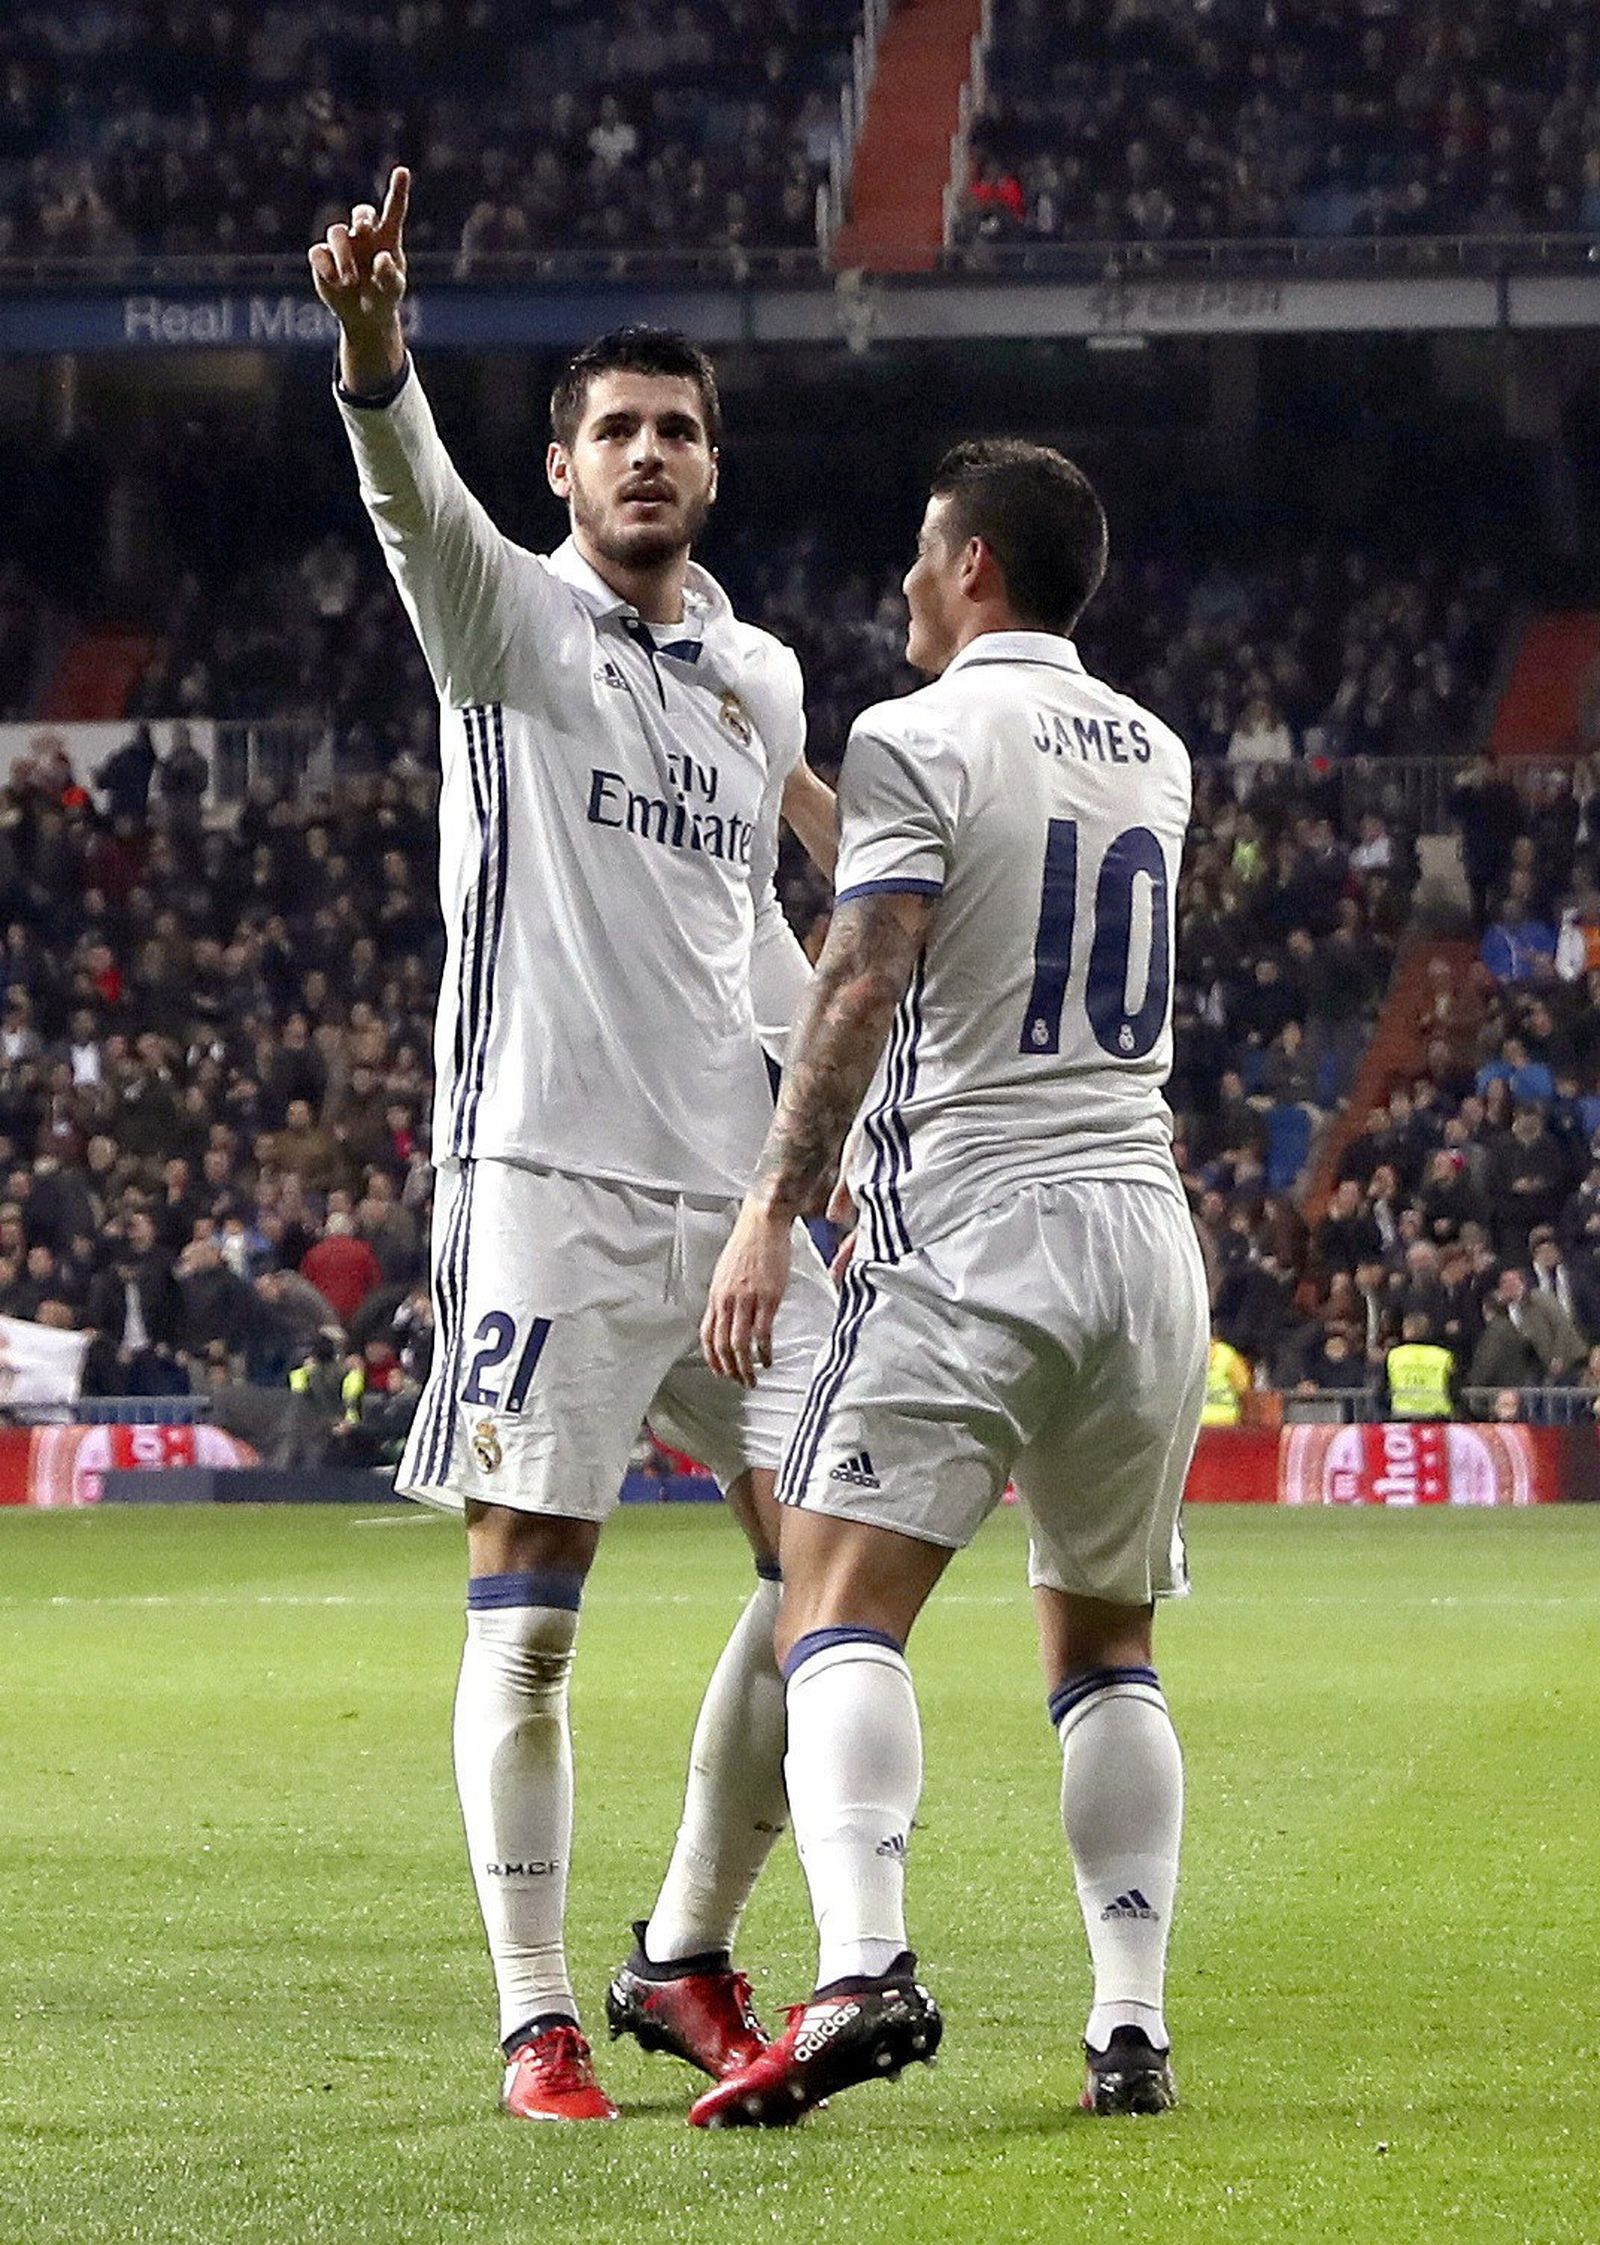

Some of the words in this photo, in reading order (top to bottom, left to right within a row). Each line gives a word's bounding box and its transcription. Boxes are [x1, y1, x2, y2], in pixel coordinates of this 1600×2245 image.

[126, 297, 232, 340] Real
[1034, 712, 1151, 763] JAMES
[1019, 817, 1169, 1059] 10
[461, 1310, 553, 1413] 21
[830, 1469, 881, 1489] adidas
[794, 2002, 861, 2062] adidas
